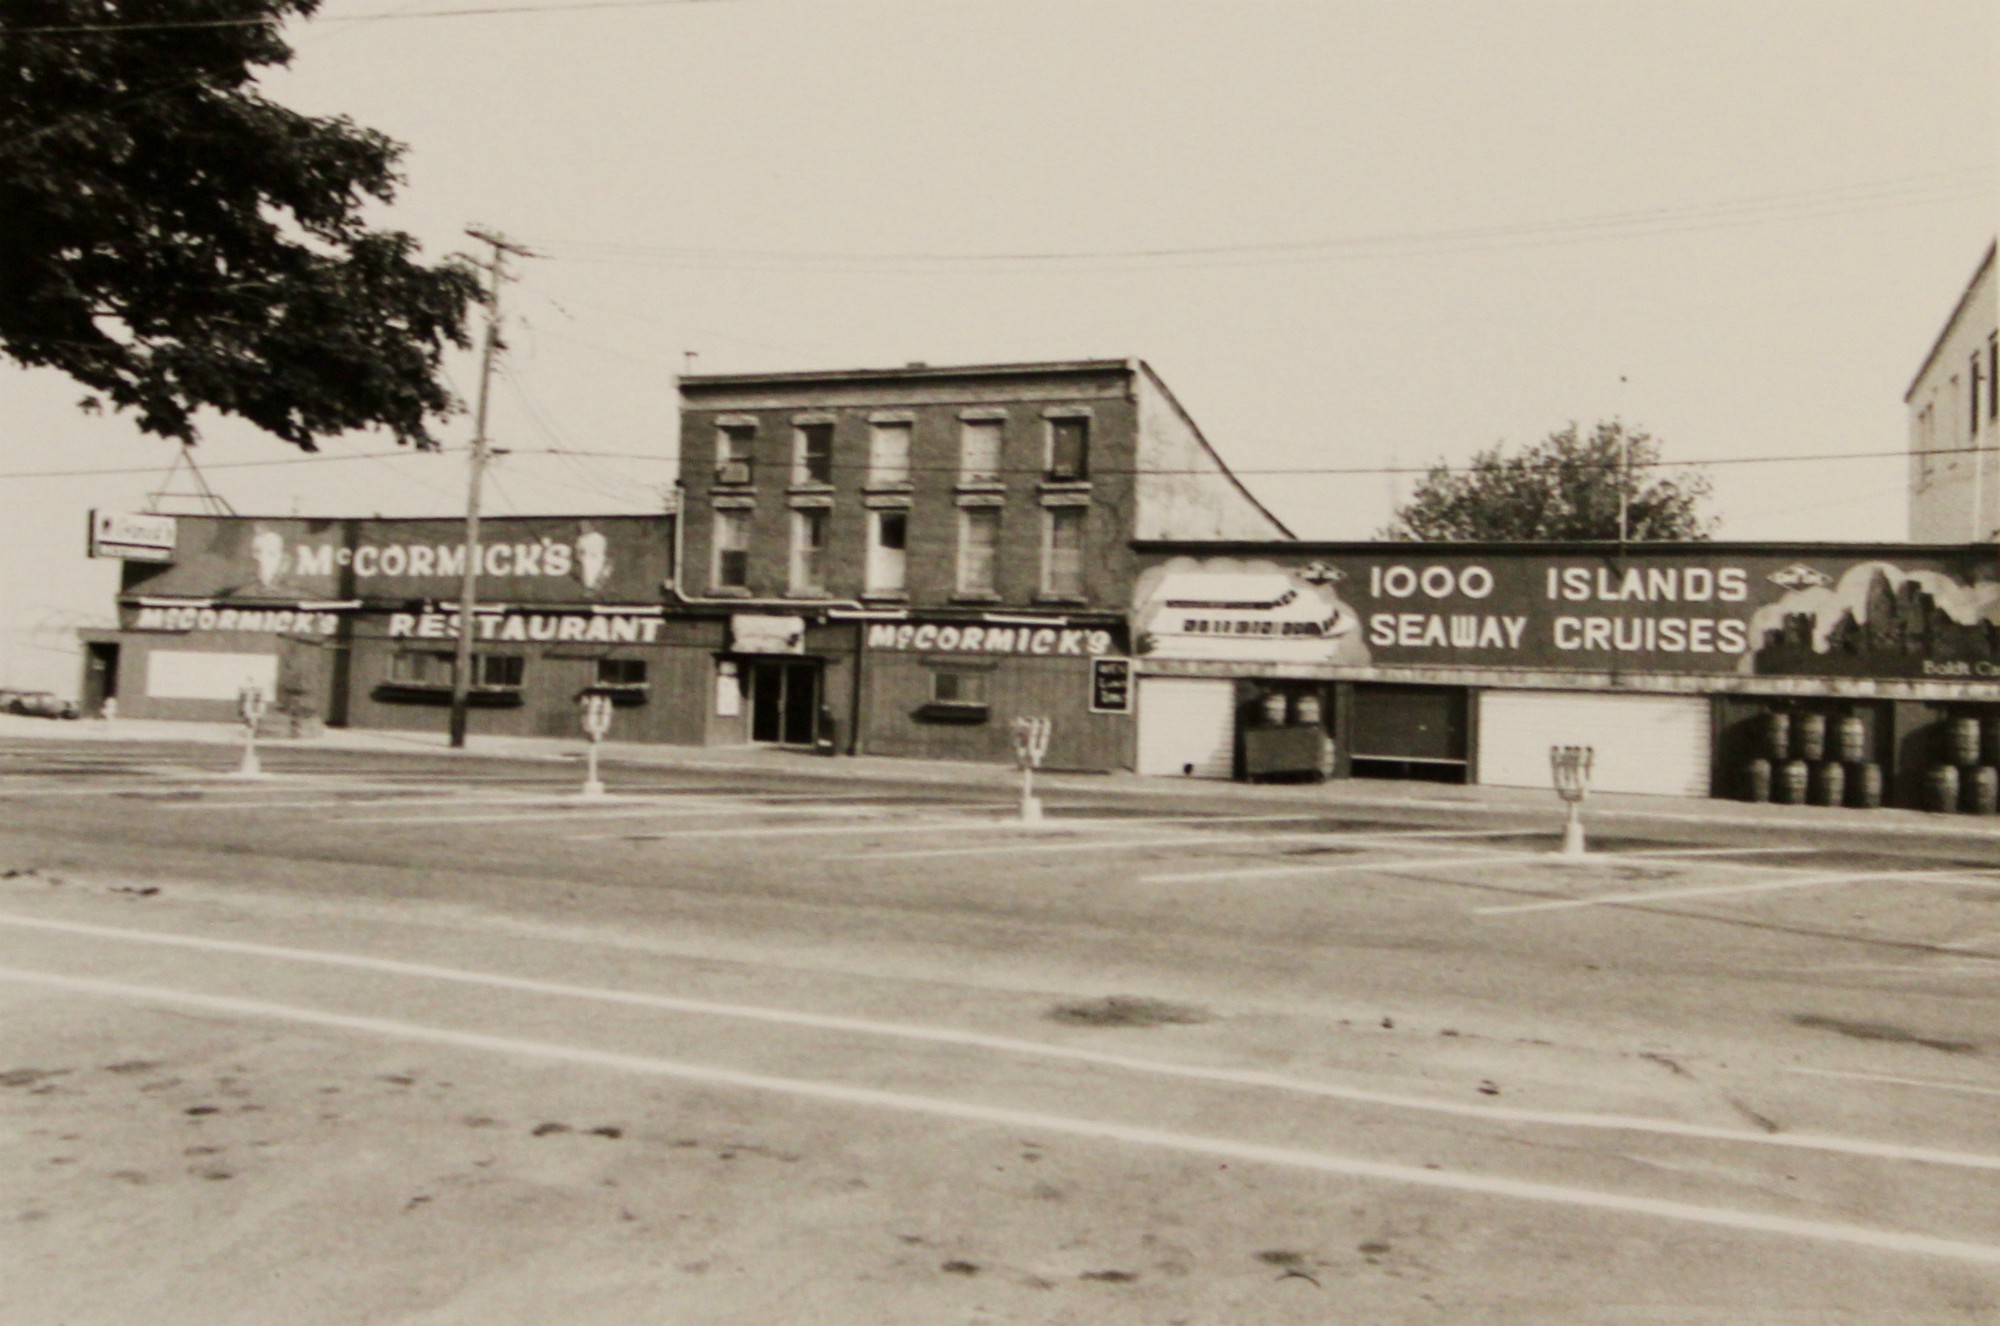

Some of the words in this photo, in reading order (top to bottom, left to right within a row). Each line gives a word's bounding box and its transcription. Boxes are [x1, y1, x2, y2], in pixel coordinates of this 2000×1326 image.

[1370, 565, 1494, 599] 1000
[1546, 566, 1748, 602] ISLANDS
[1369, 613, 1528, 649] SEAWAY
[1552, 616, 1748, 654] CRUISES
